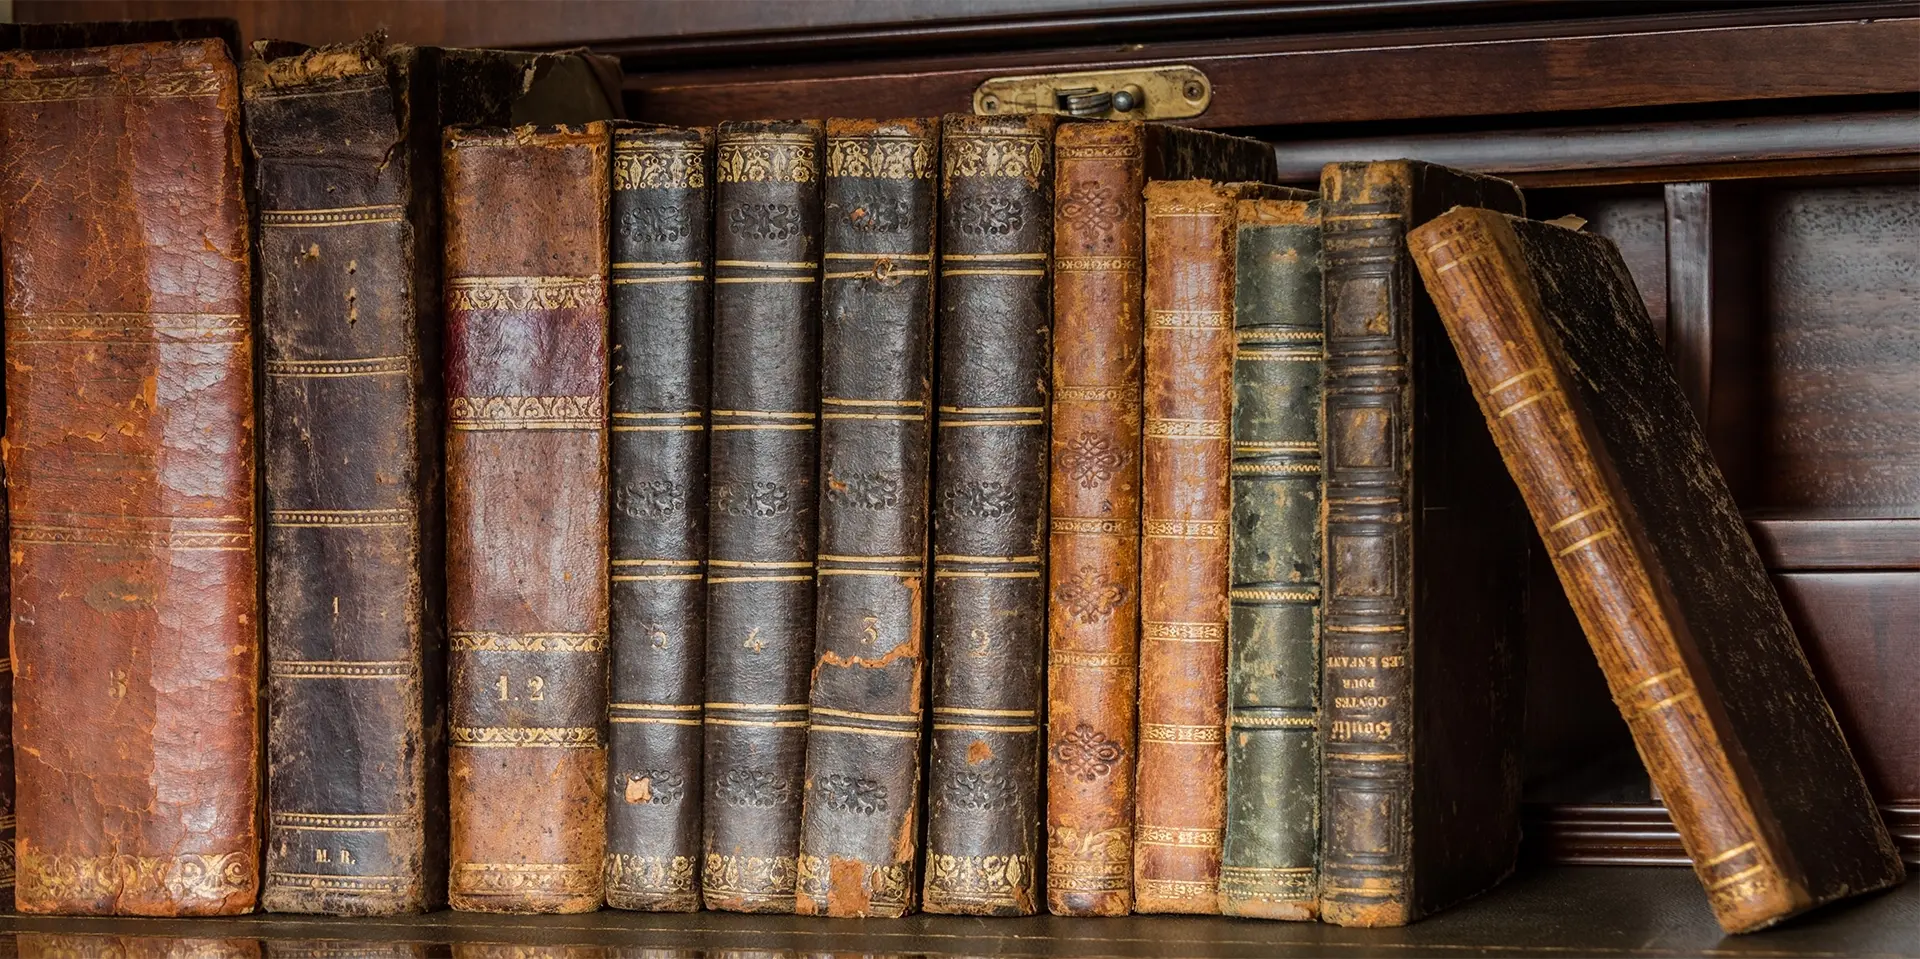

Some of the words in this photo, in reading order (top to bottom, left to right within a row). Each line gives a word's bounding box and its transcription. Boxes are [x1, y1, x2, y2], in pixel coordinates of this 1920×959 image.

[861, 615, 878, 645] 3
[743, 626, 769, 654] 4
[970, 627, 992, 657] 2
[1381, 656, 1405, 668] LES
[1342, 678, 1375, 689] POUR
[1334, 696, 1388, 708] CONTES
[315, 848, 331, 863] M.
